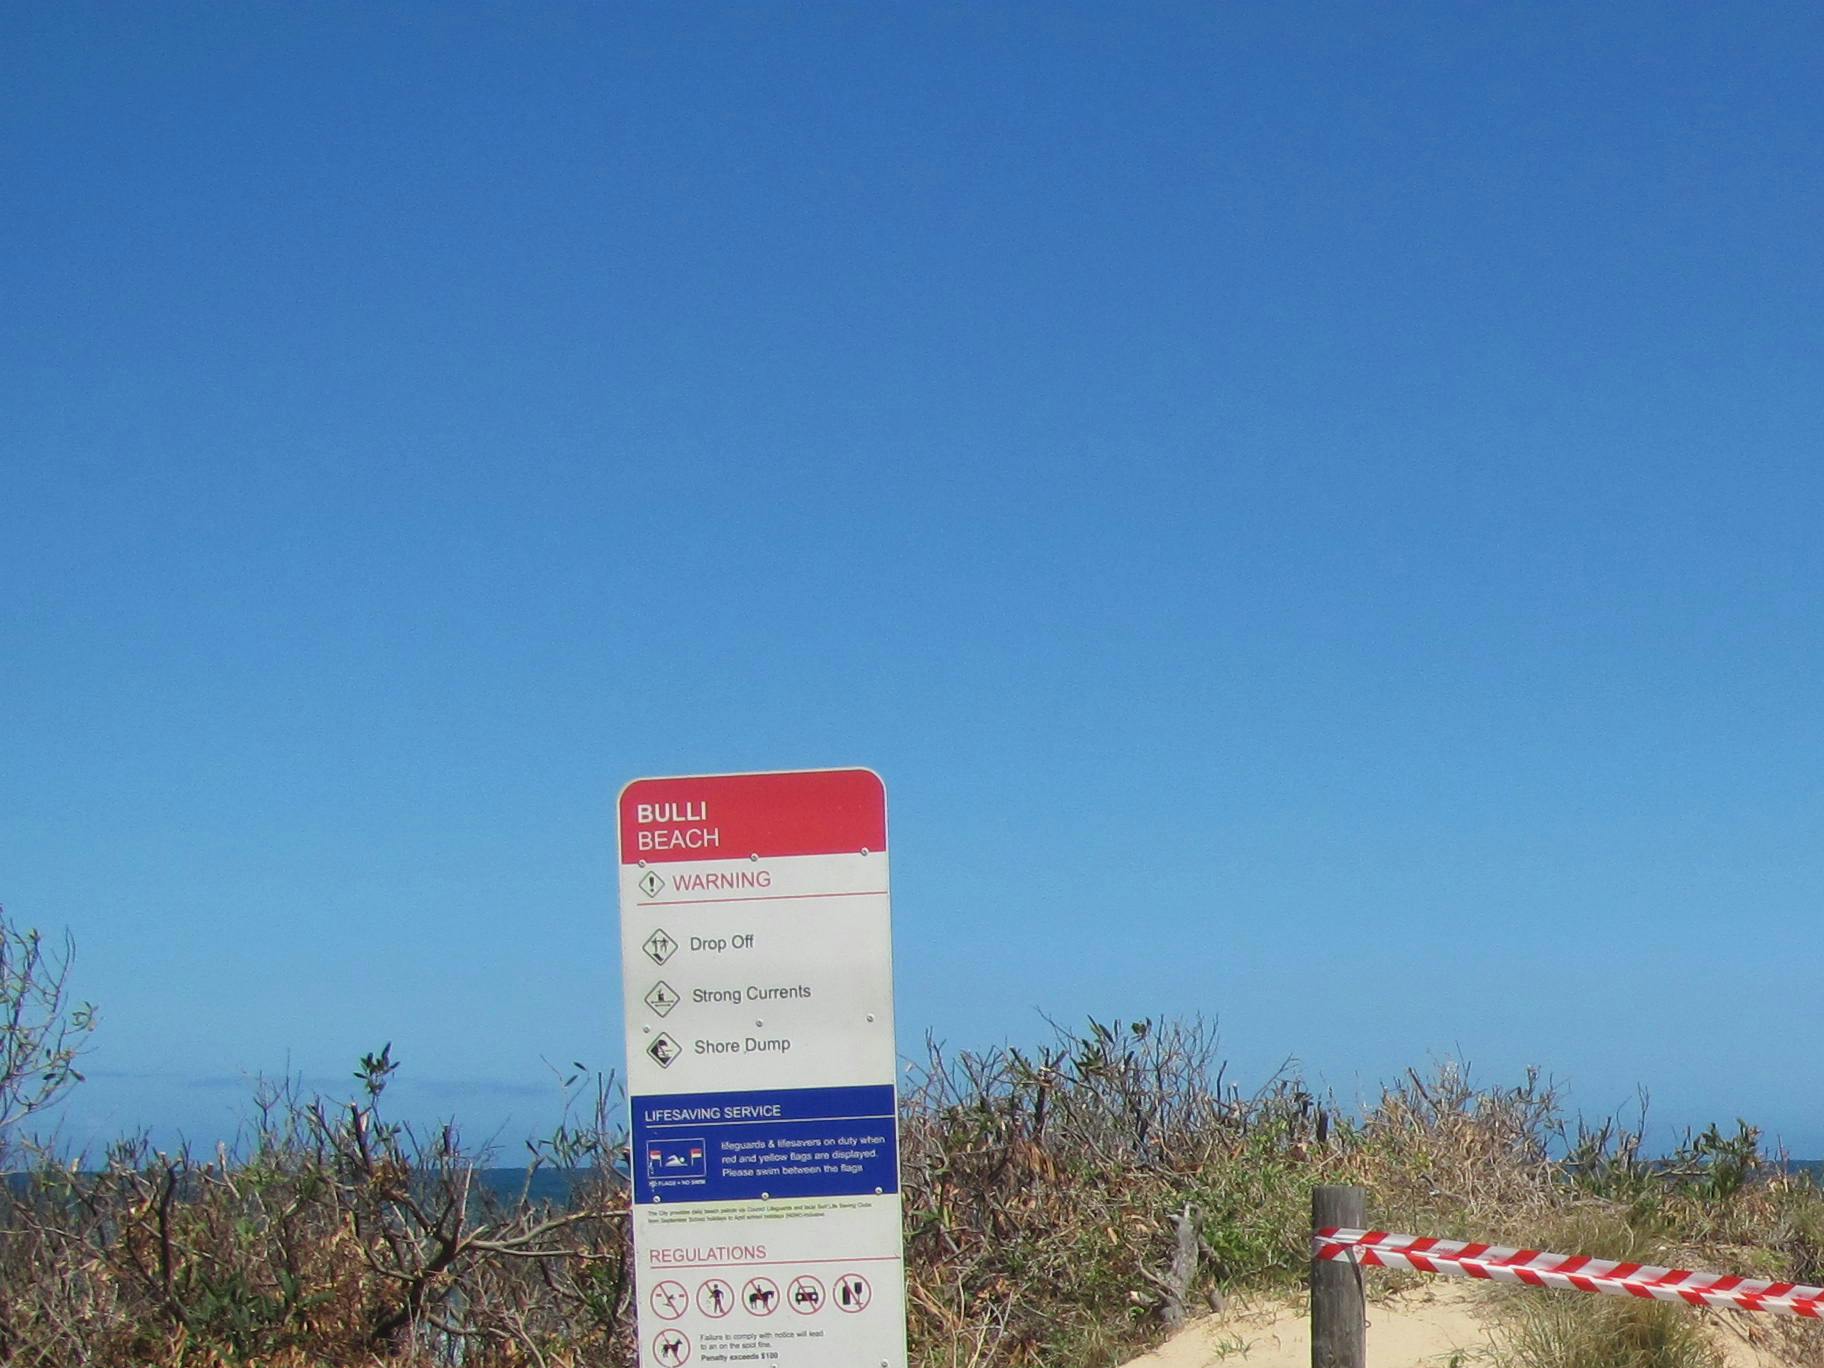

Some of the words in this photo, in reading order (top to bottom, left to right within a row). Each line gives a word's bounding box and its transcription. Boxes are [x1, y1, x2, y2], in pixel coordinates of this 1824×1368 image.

[637, 802, 706, 823] BULLI
[638, 828, 719, 850] BEACH
[672, 871, 771, 890] WARNING
[690, 937, 727, 953] Drop
[731, 934, 754, 949] Off
[692, 989, 742, 1004] Strong
[746, 986, 811, 1000] Currents
[694, 1040, 740, 1054] Shore
[744, 1038, 791, 1053] Dump
[645, 1108, 721, 1122] LIFESAVING
[724, 1105, 781, 1118] SERVICE
[722, 1168, 754, 1177] Please
[756, 1168, 780, 1176] swim
[781, 1166, 822, 1174] between
[823, 1165, 839, 1173] the
[840, 1164, 863, 1173] flags
[649, 1245, 767, 1263] REGULATIONS
